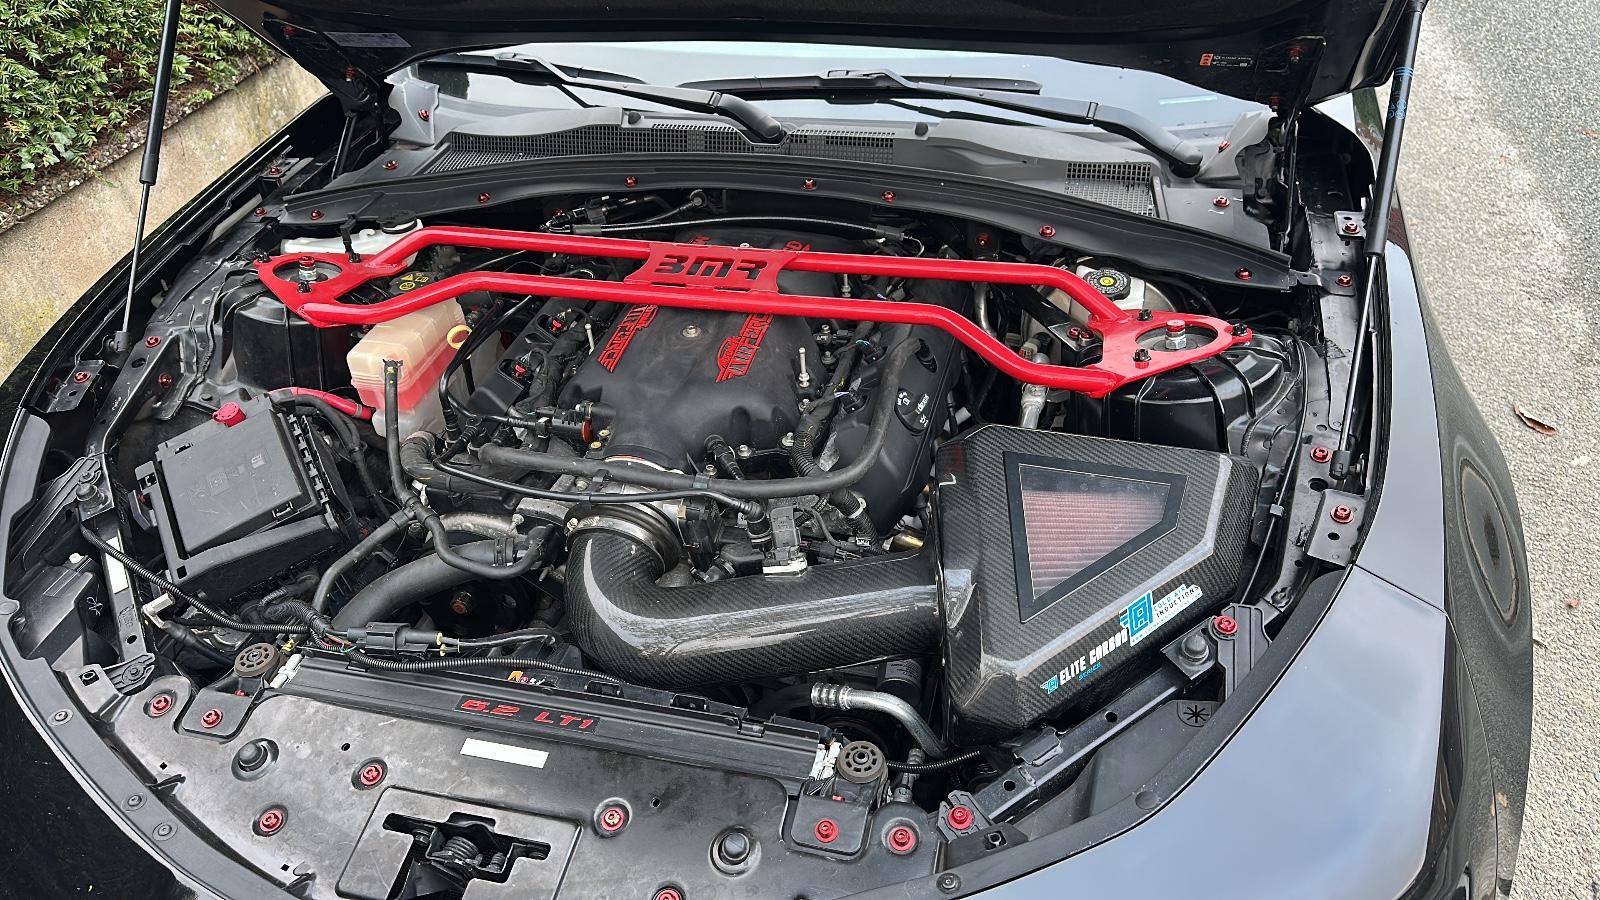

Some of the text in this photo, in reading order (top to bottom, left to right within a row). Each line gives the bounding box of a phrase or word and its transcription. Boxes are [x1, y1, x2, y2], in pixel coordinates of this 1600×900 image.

[654, 254, 768, 281] BMR
[1156, 586, 1199, 618] INDUCTIONS
[1060, 656, 1087, 686] ELITE
[1089, 629, 1128, 665] CARBON
[461, 699, 594, 729] 6.2 LT1
